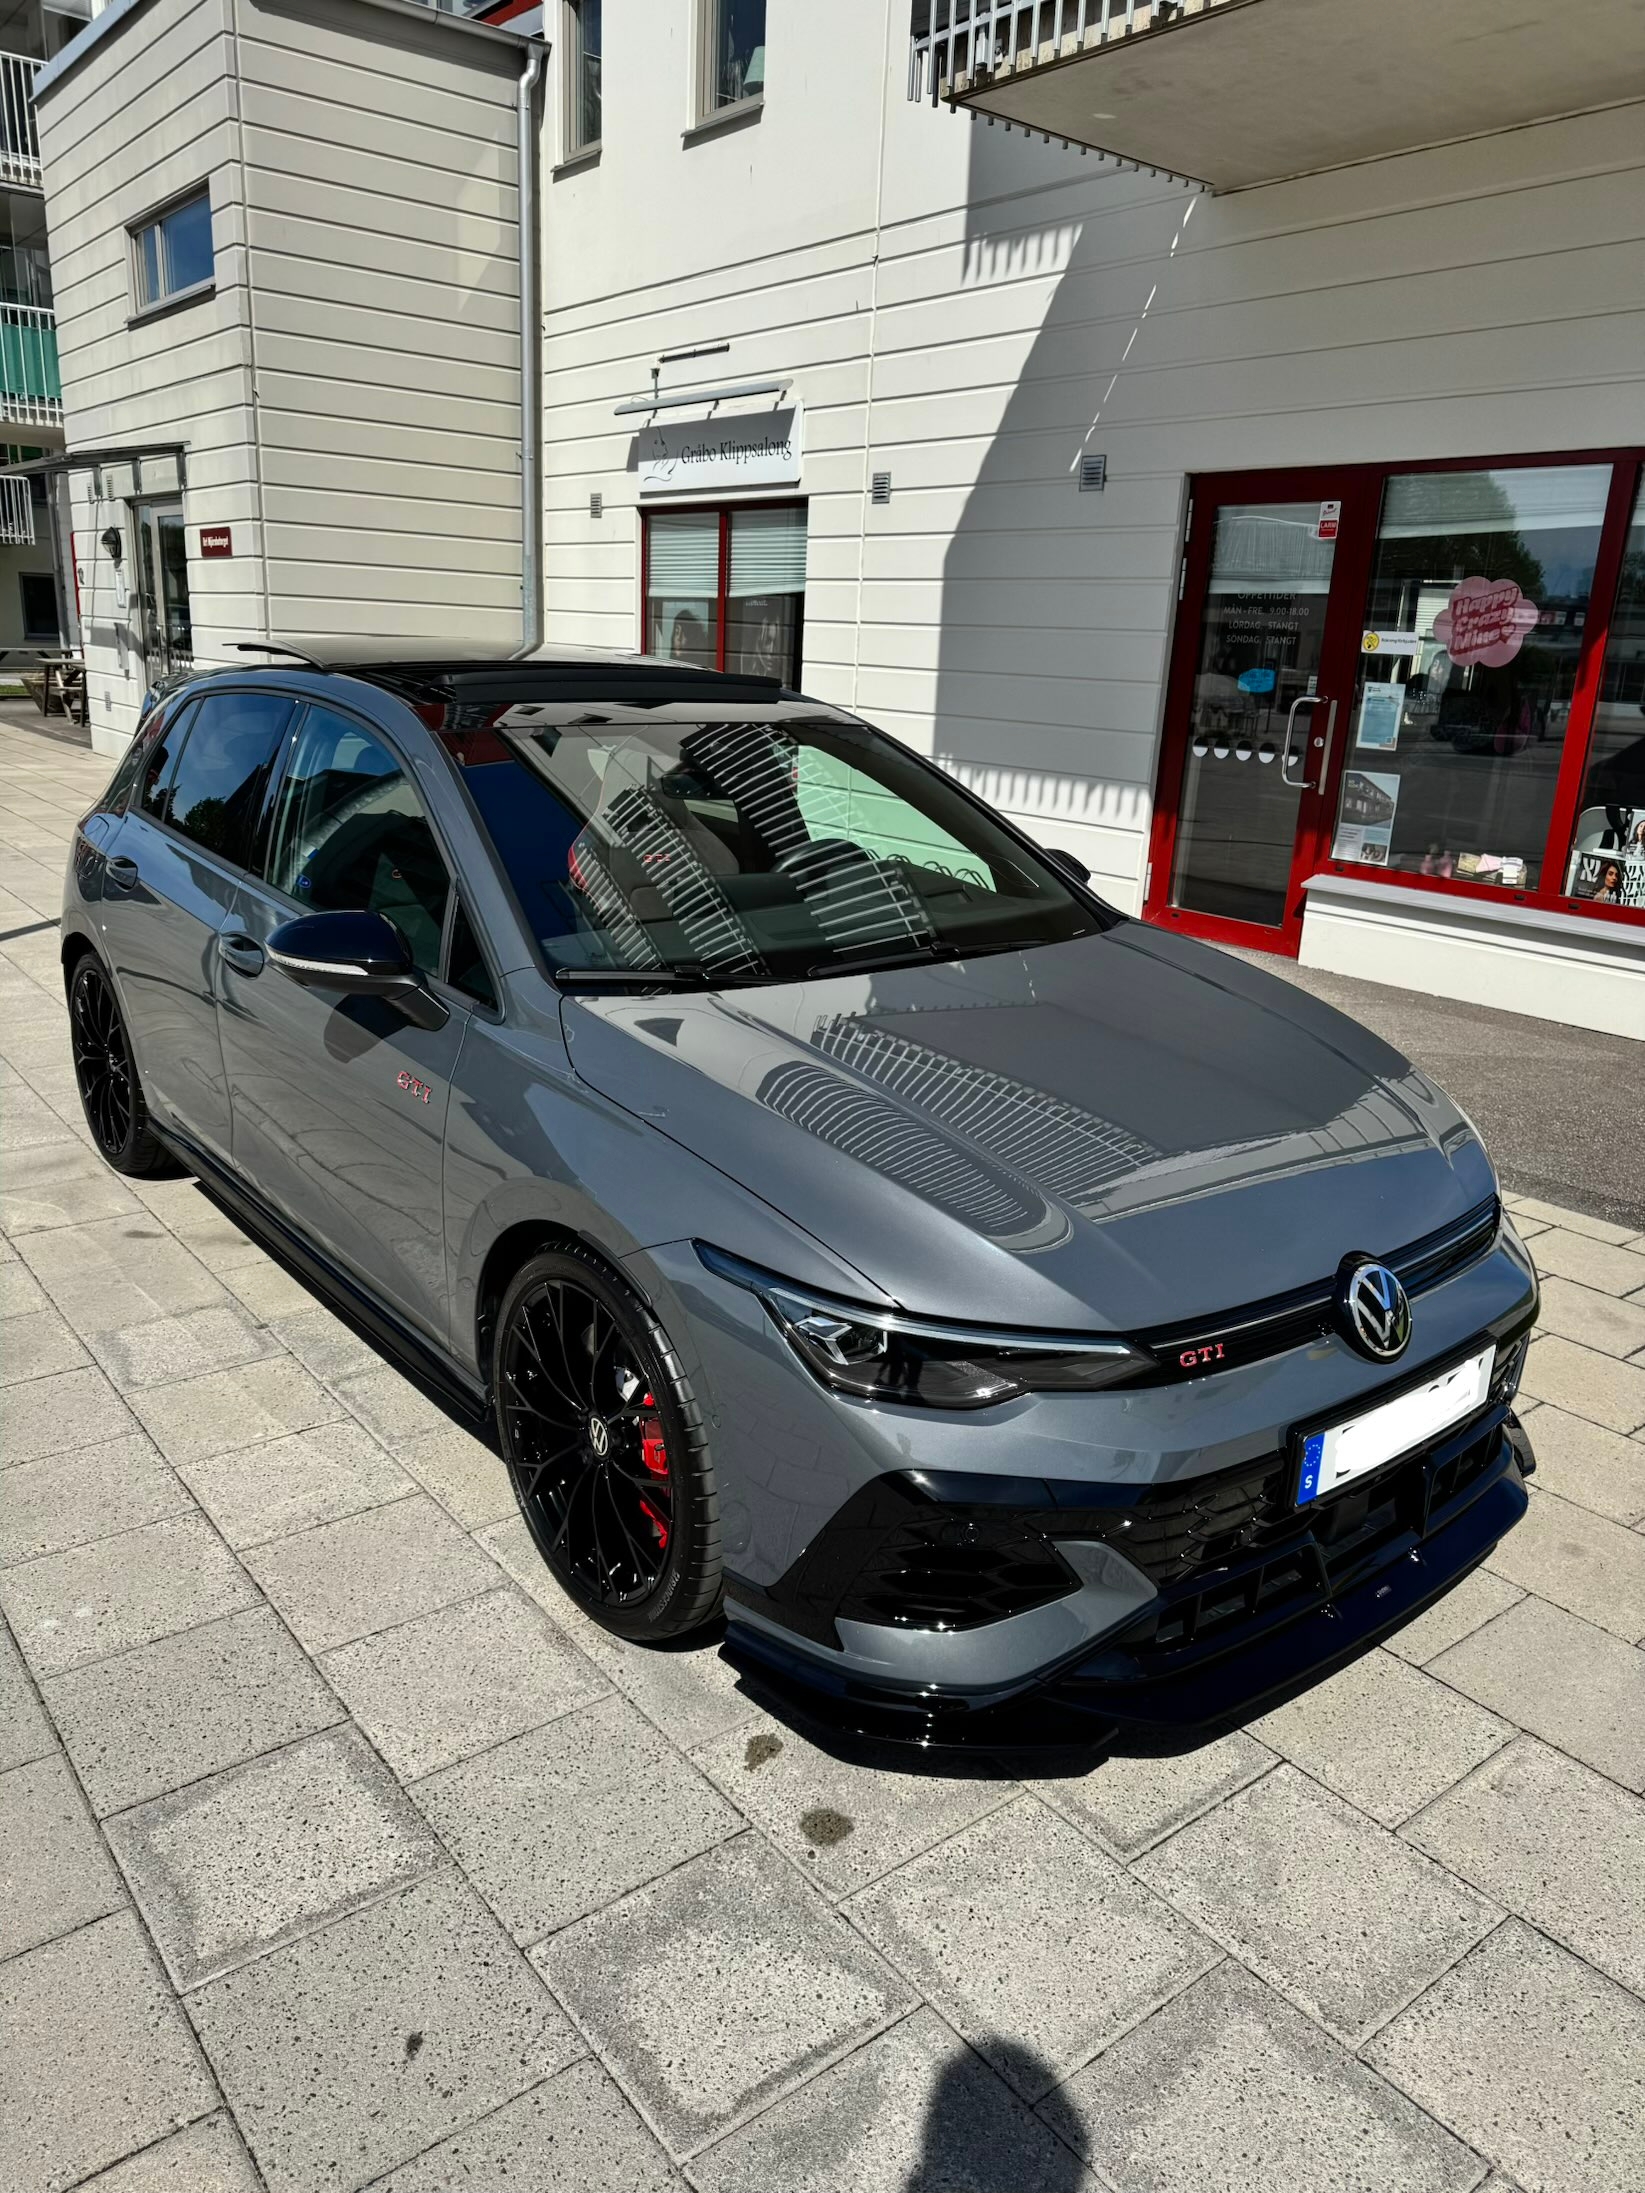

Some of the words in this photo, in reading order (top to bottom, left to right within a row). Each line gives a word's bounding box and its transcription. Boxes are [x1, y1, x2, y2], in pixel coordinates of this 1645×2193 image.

[681, 443, 717, 464] Gråbo
[720, 436, 792, 464] Klippsalong
[1454, 587, 1518, 616] Happy
[1454, 607, 1514, 634] Crazy
[1453, 629, 1501, 651] Mine
[397, 1071, 432, 1104] GTI
[1179, 1343, 1225, 1367] GTI
[1304, 1474, 1314, 1489] S
